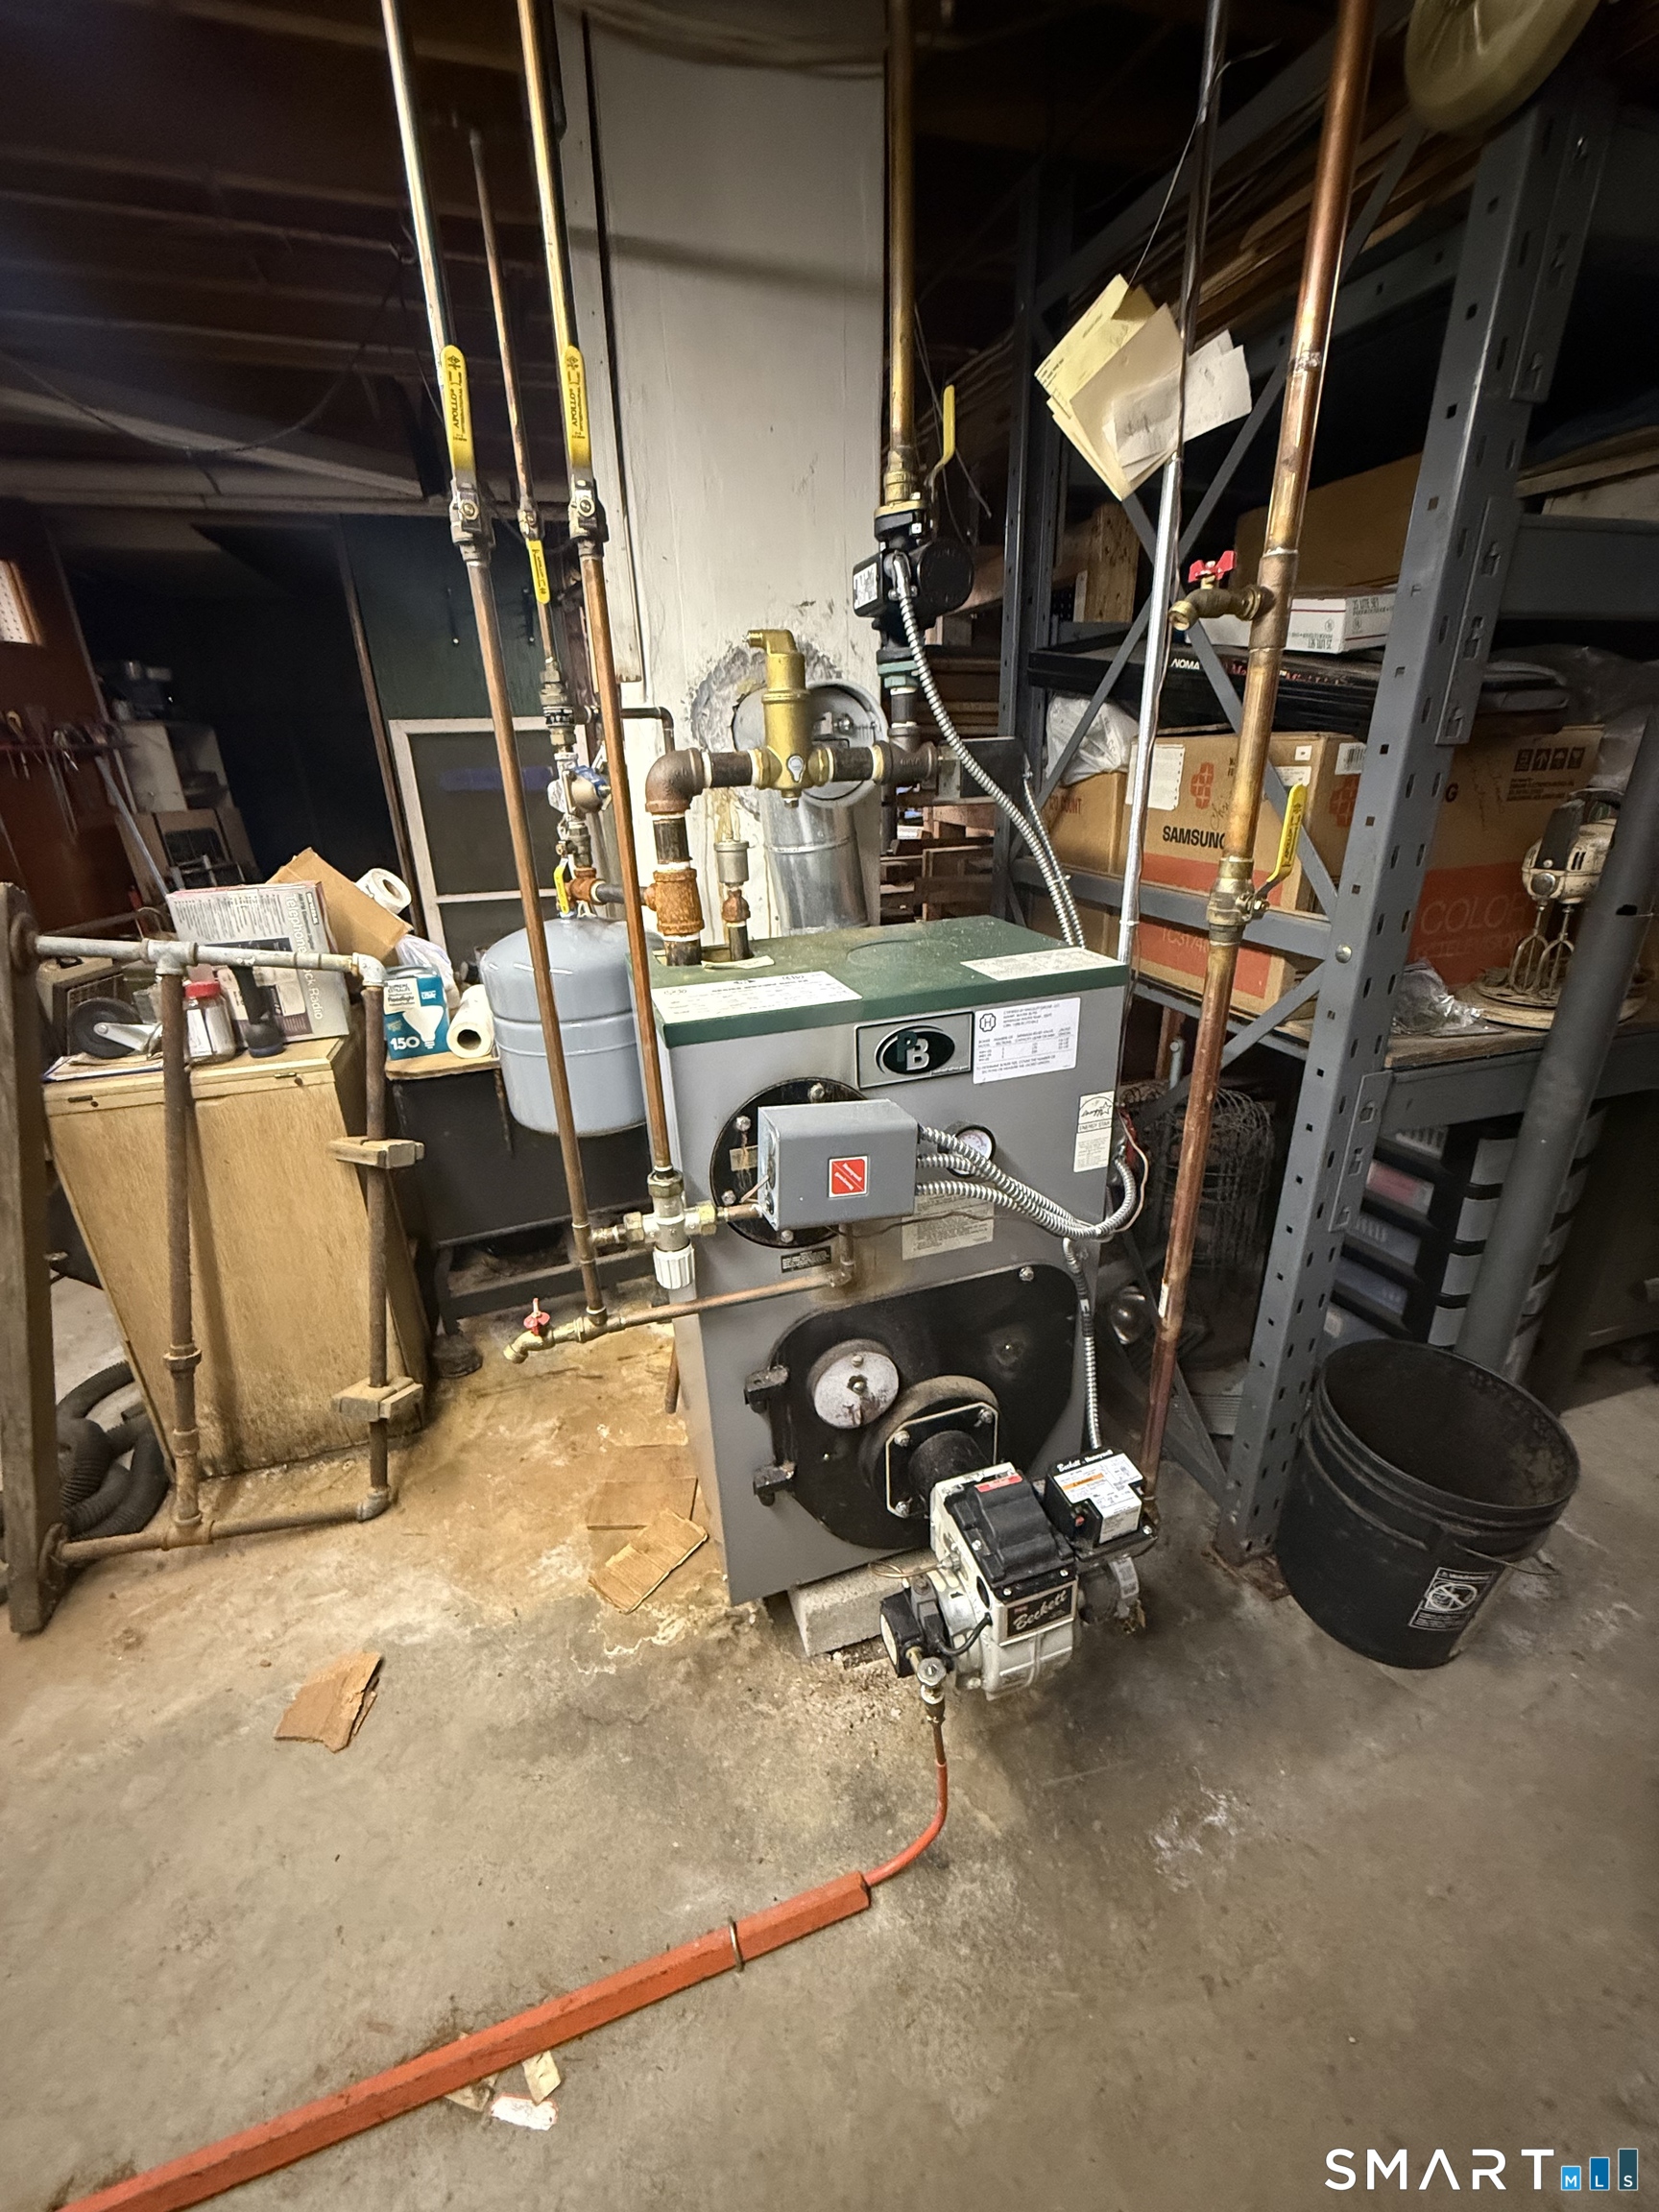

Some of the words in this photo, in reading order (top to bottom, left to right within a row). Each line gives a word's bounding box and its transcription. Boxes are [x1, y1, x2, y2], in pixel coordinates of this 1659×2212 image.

[1170, 658, 1200, 670] NOMA
[285, 893, 307, 954] Telephone
[308, 988, 323, 1021] Radio
[390, 1036, 421, 1051] 150
[1056, 1459, 1081, 1473] Beckett
[1013, 1589, 1069, 1631] Beckett
